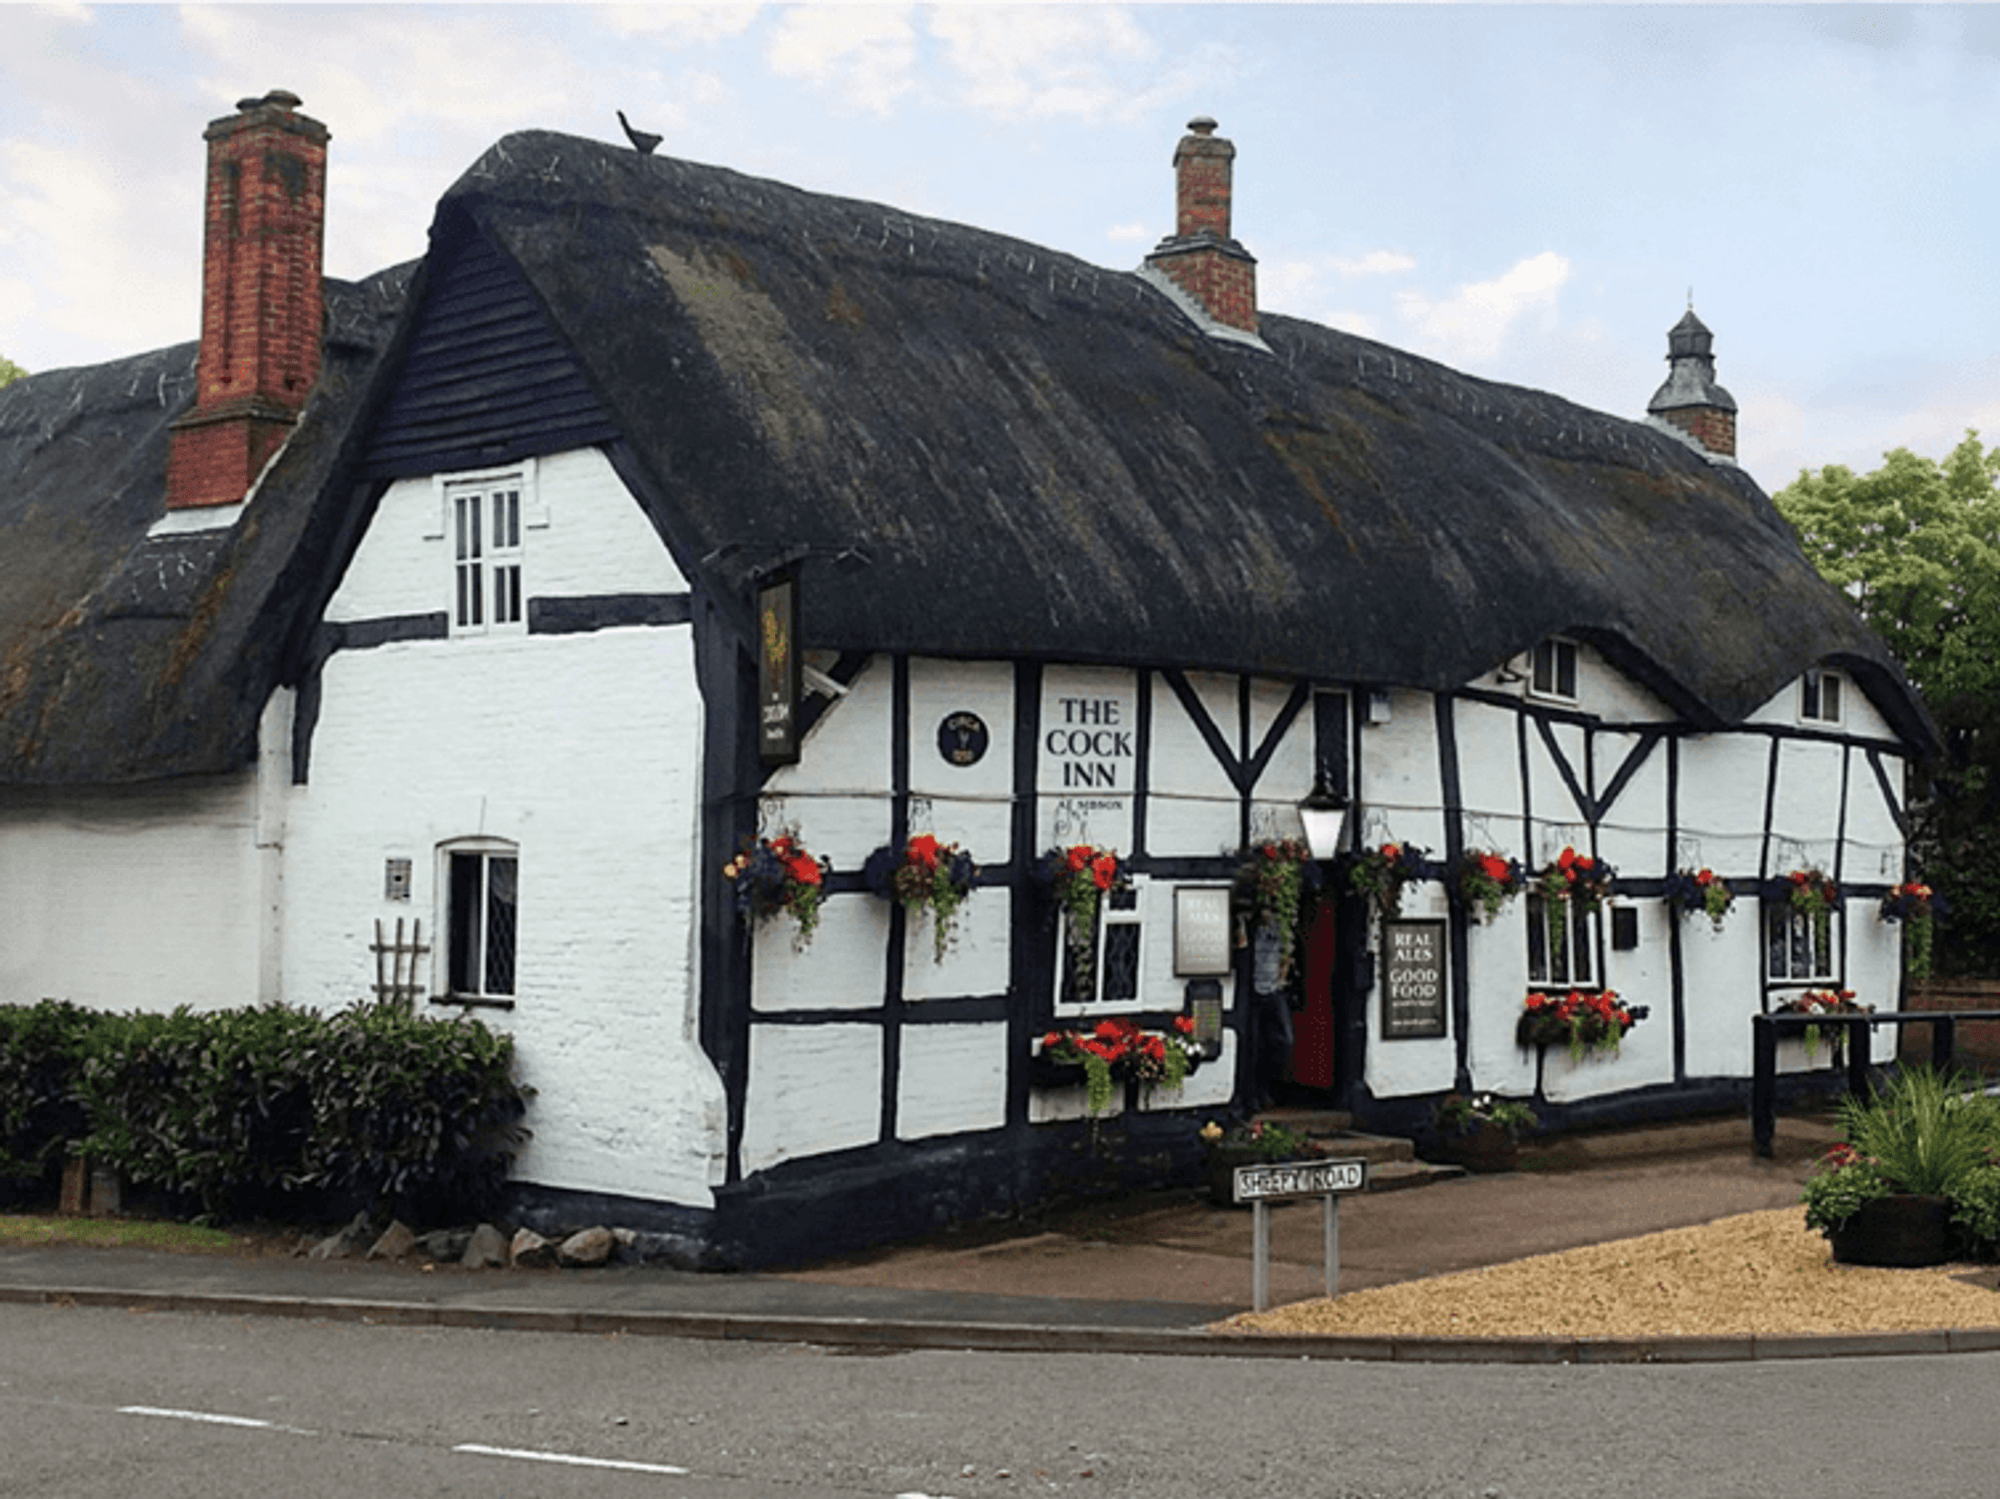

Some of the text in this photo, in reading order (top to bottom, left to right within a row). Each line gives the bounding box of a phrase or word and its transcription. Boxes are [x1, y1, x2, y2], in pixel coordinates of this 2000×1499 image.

[1058, 698, 1120, 725] THE
[1046, 729, 1133, 757] COCK
[1063, 762, 1116, 787] INN
[1395, 933, 1433, 946] REAL
[1395, 948, 1434, 962] ALES
[1390, 967, 1438, 983] GOOD
[1392, 983, 1437, 998] FOOD
[1313, 1167, 1359, 1189] ROAD
